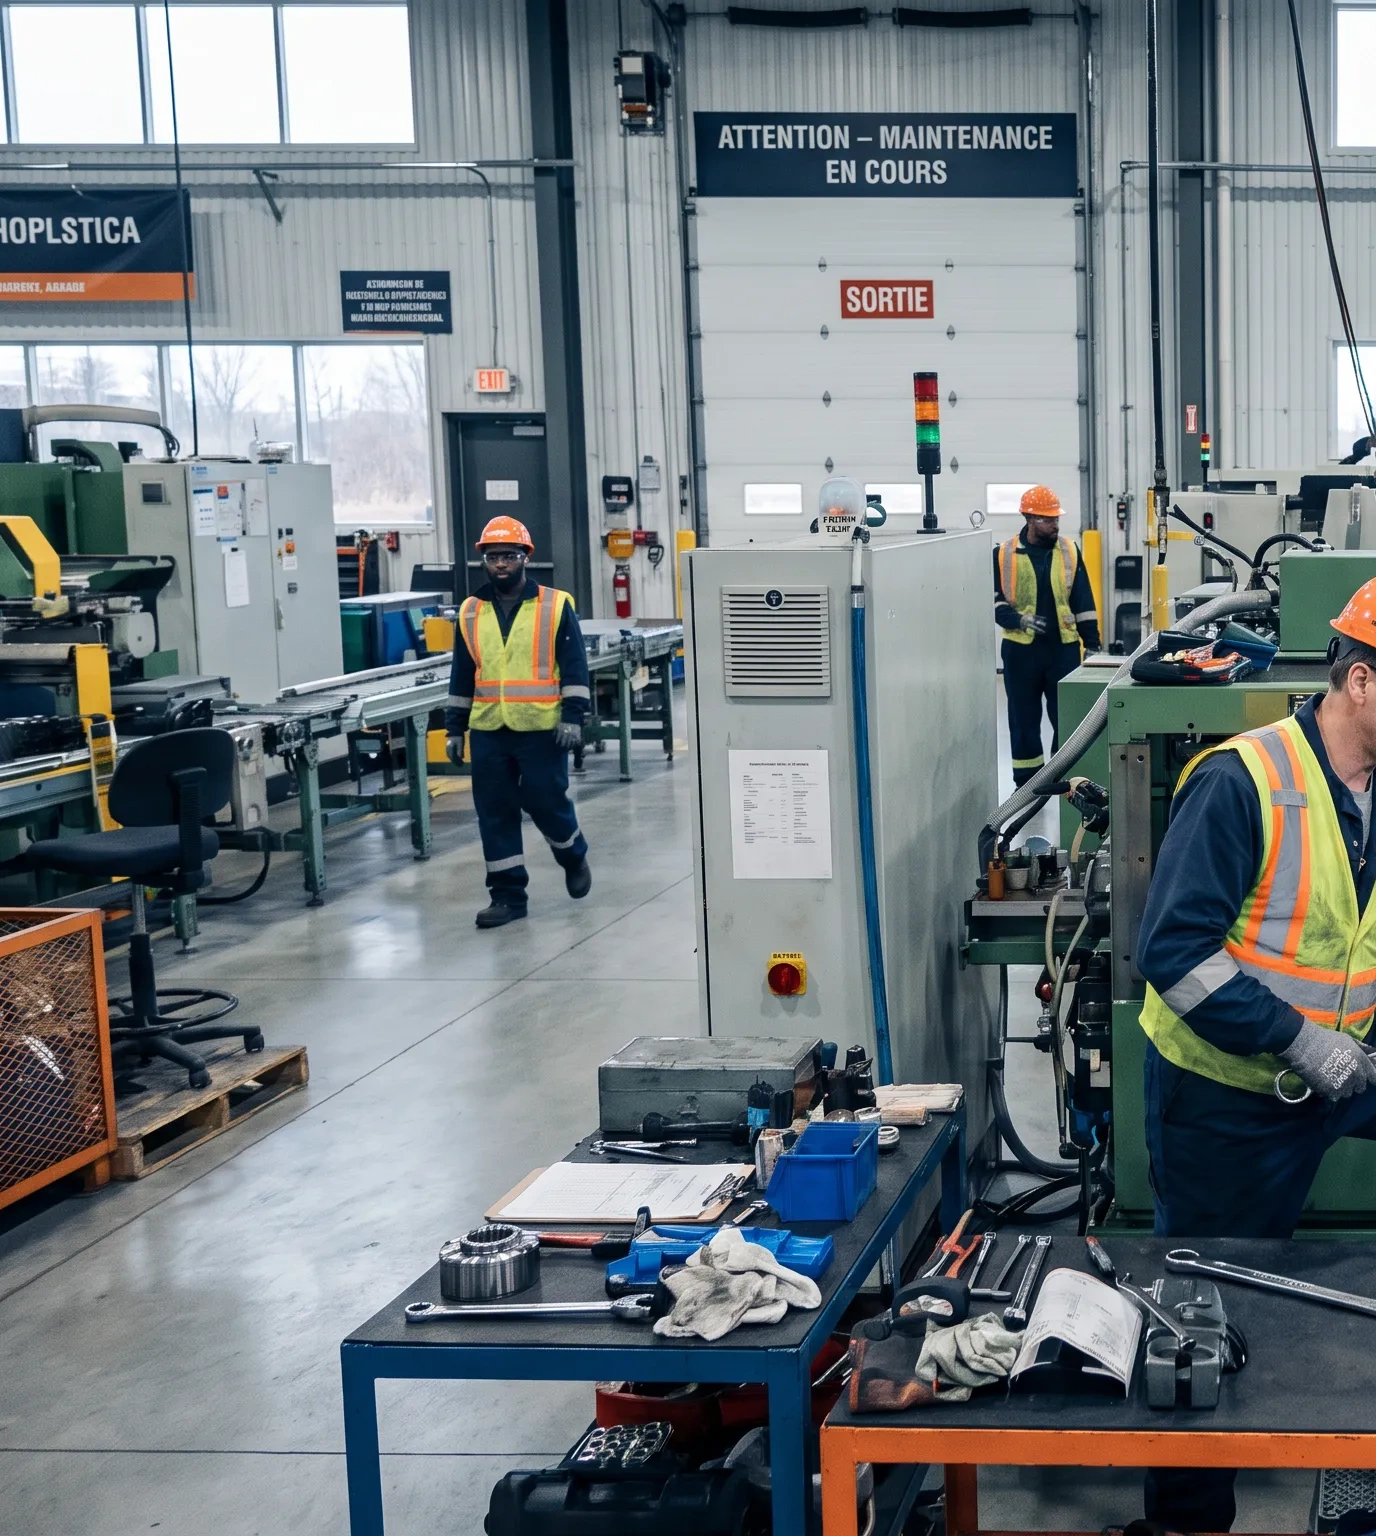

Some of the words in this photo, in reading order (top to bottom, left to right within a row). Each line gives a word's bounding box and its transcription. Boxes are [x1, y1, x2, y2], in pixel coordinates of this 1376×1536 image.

[718, 125, 850, 150] ATTENTION
[879, 125, 1053, 151] MAINTENANCE
[826, 160, 856, 184] EN
[865, 159, 948, 185] COURS
[846, 286, 929, 314] SORTIE
[479, 371, 505, 390] EXIT
